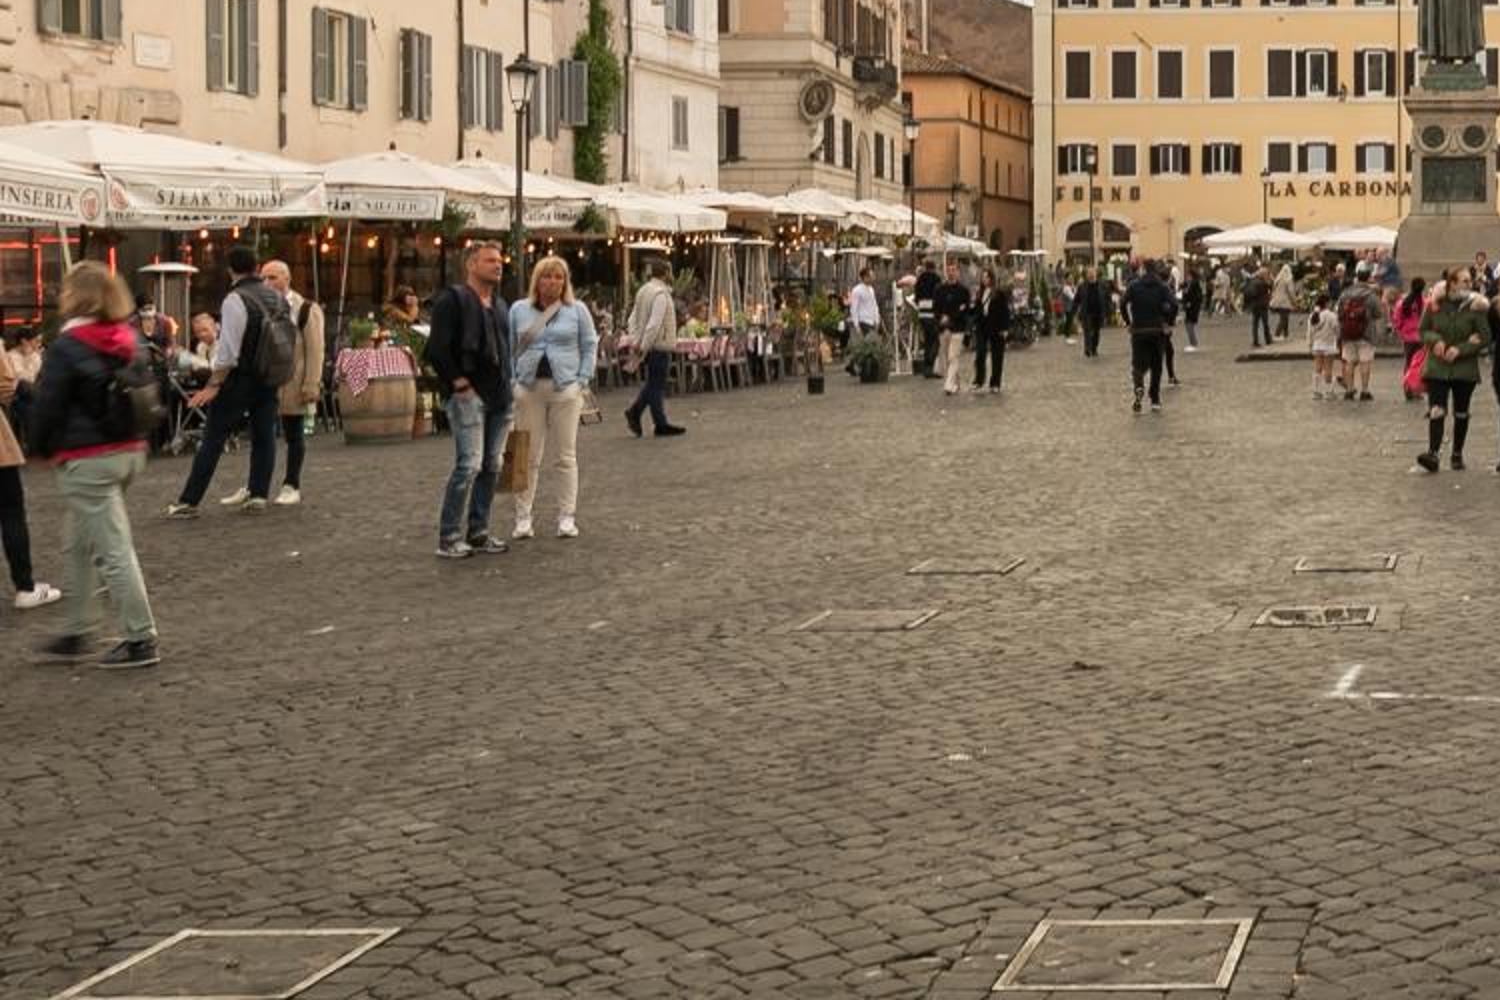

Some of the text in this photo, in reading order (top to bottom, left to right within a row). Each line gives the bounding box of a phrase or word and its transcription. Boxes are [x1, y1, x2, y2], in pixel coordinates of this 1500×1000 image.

[1056, 186, 1141, 202] FORNO
[1269, 181, 1412, 197] LA CARBONA
[156, 189, 211, 206] STEAK
[235, 191, 285, 208] HOUSE
